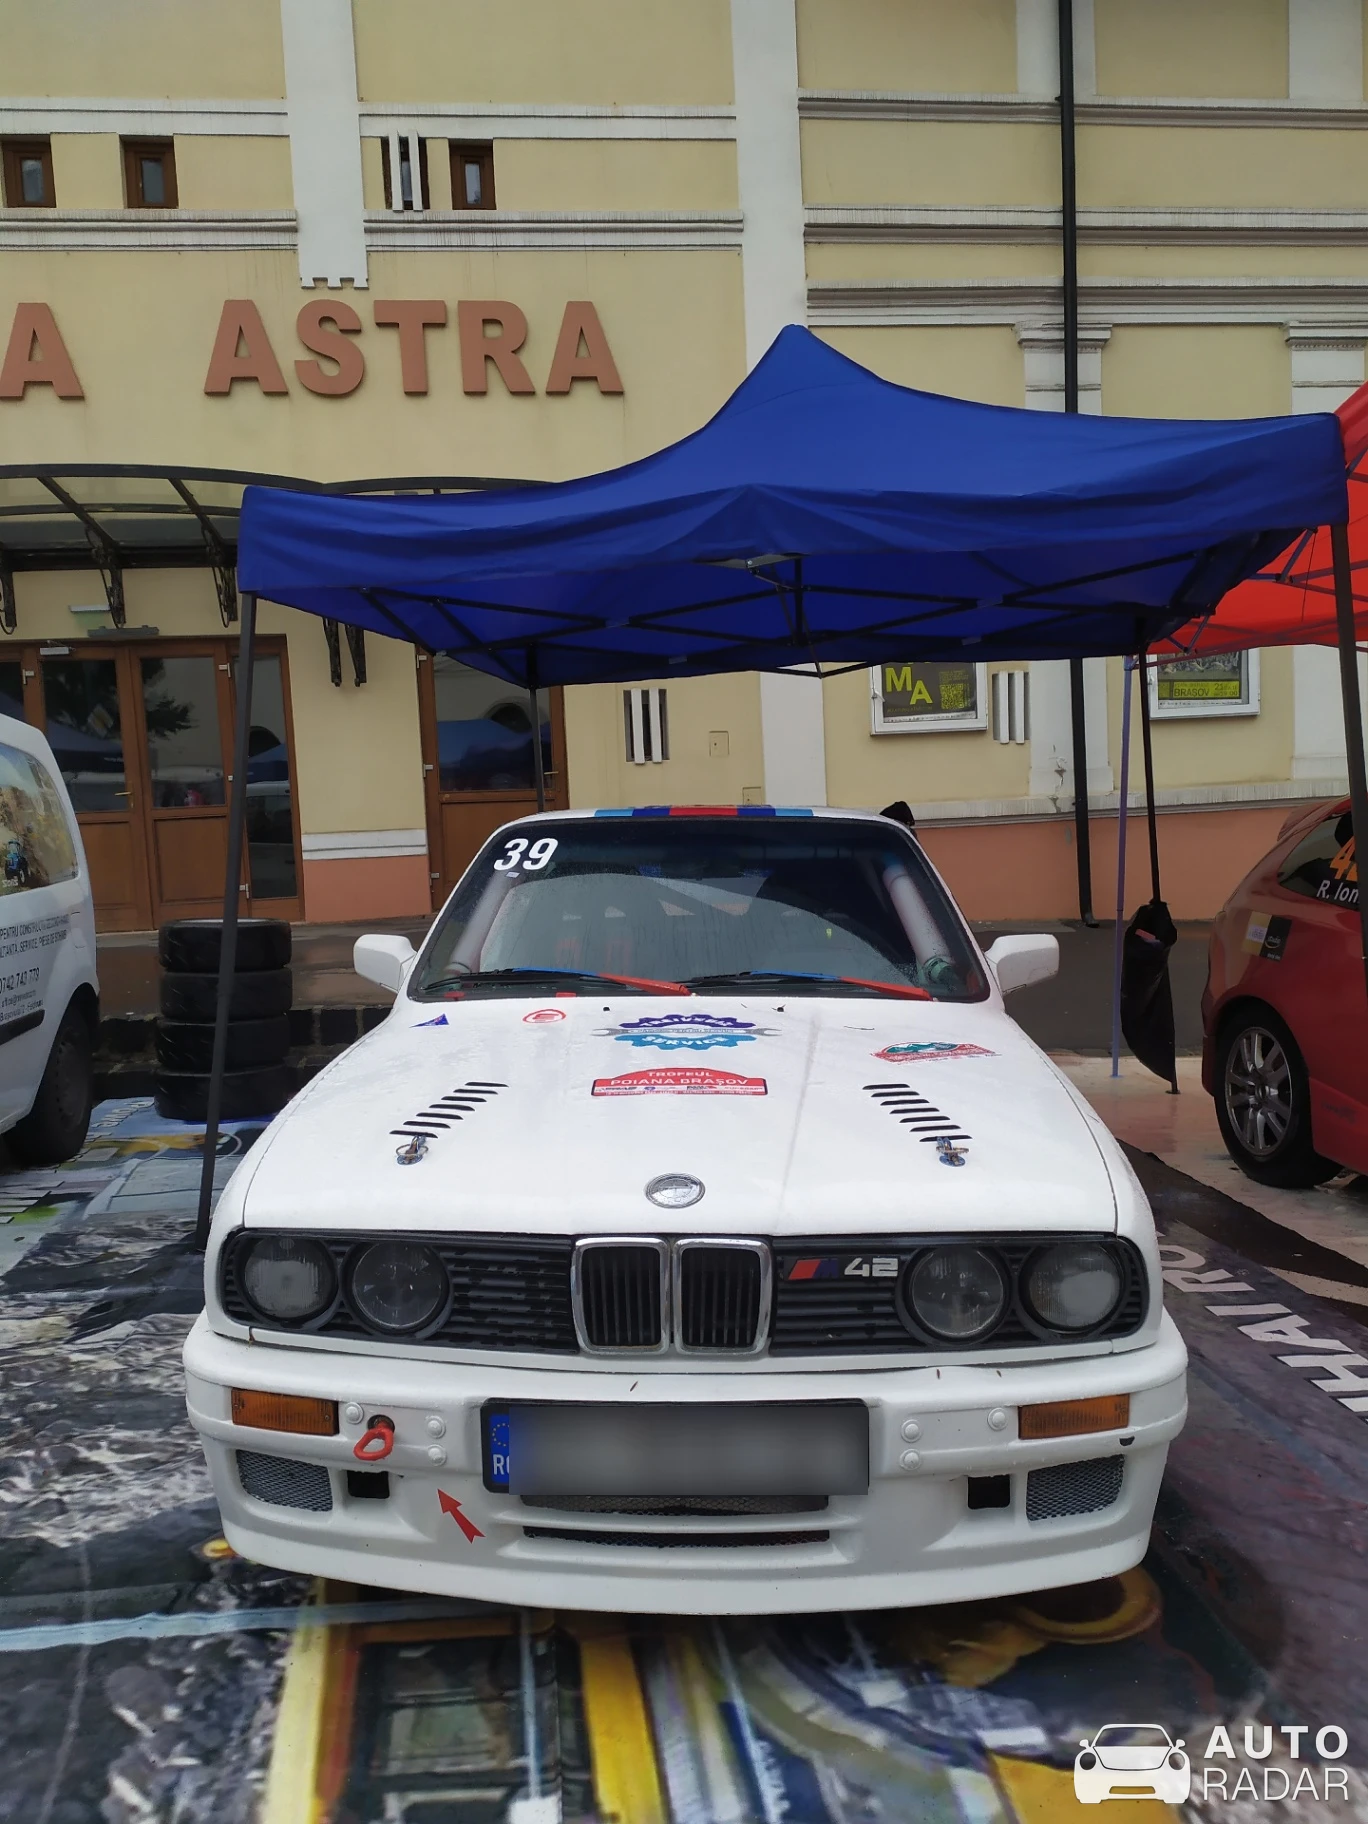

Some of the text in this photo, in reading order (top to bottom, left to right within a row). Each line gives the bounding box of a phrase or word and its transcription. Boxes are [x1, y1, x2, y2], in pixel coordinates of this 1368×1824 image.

[204, 299, 625, 397] ASTRA
[493, 838, 559, 871] 39
[1316, 879, 1360, 904] R. Ion
[642, 1035, 729, 1046] SERVICE
[844, 1257, 899, 1278] 42
